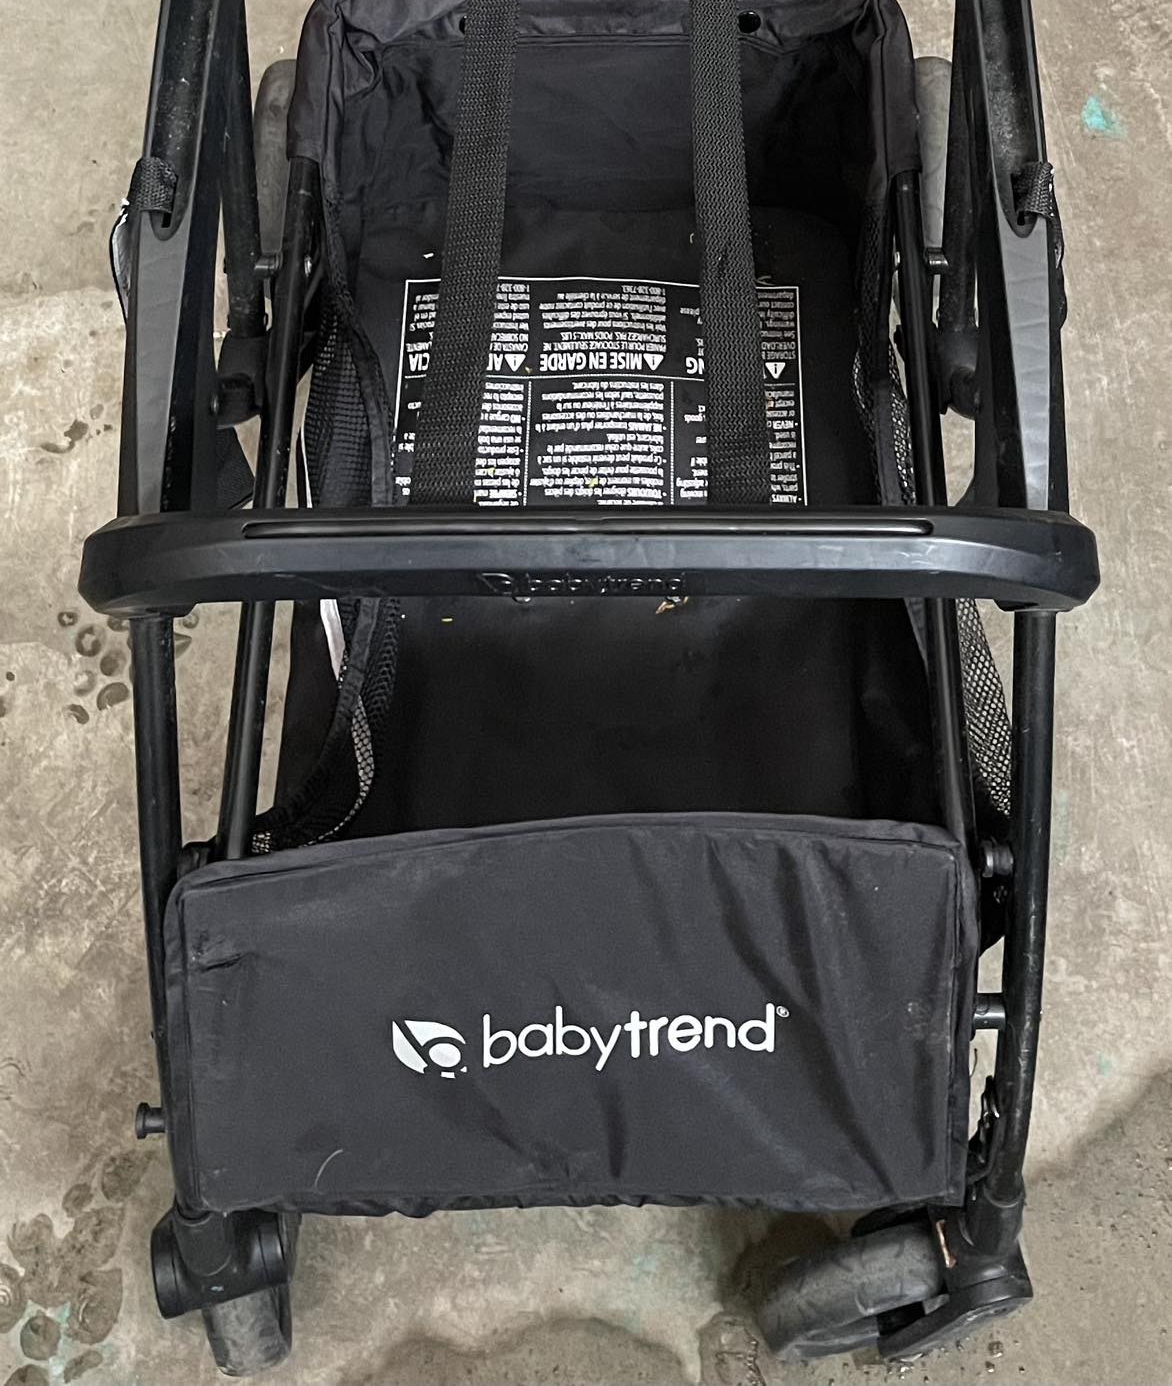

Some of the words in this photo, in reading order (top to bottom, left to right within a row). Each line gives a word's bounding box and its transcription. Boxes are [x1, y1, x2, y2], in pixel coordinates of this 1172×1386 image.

[539, 352, 586, 371] GARDE
[589, 352, 607, 369] EN
[609, 352, 642, 370] MISE
